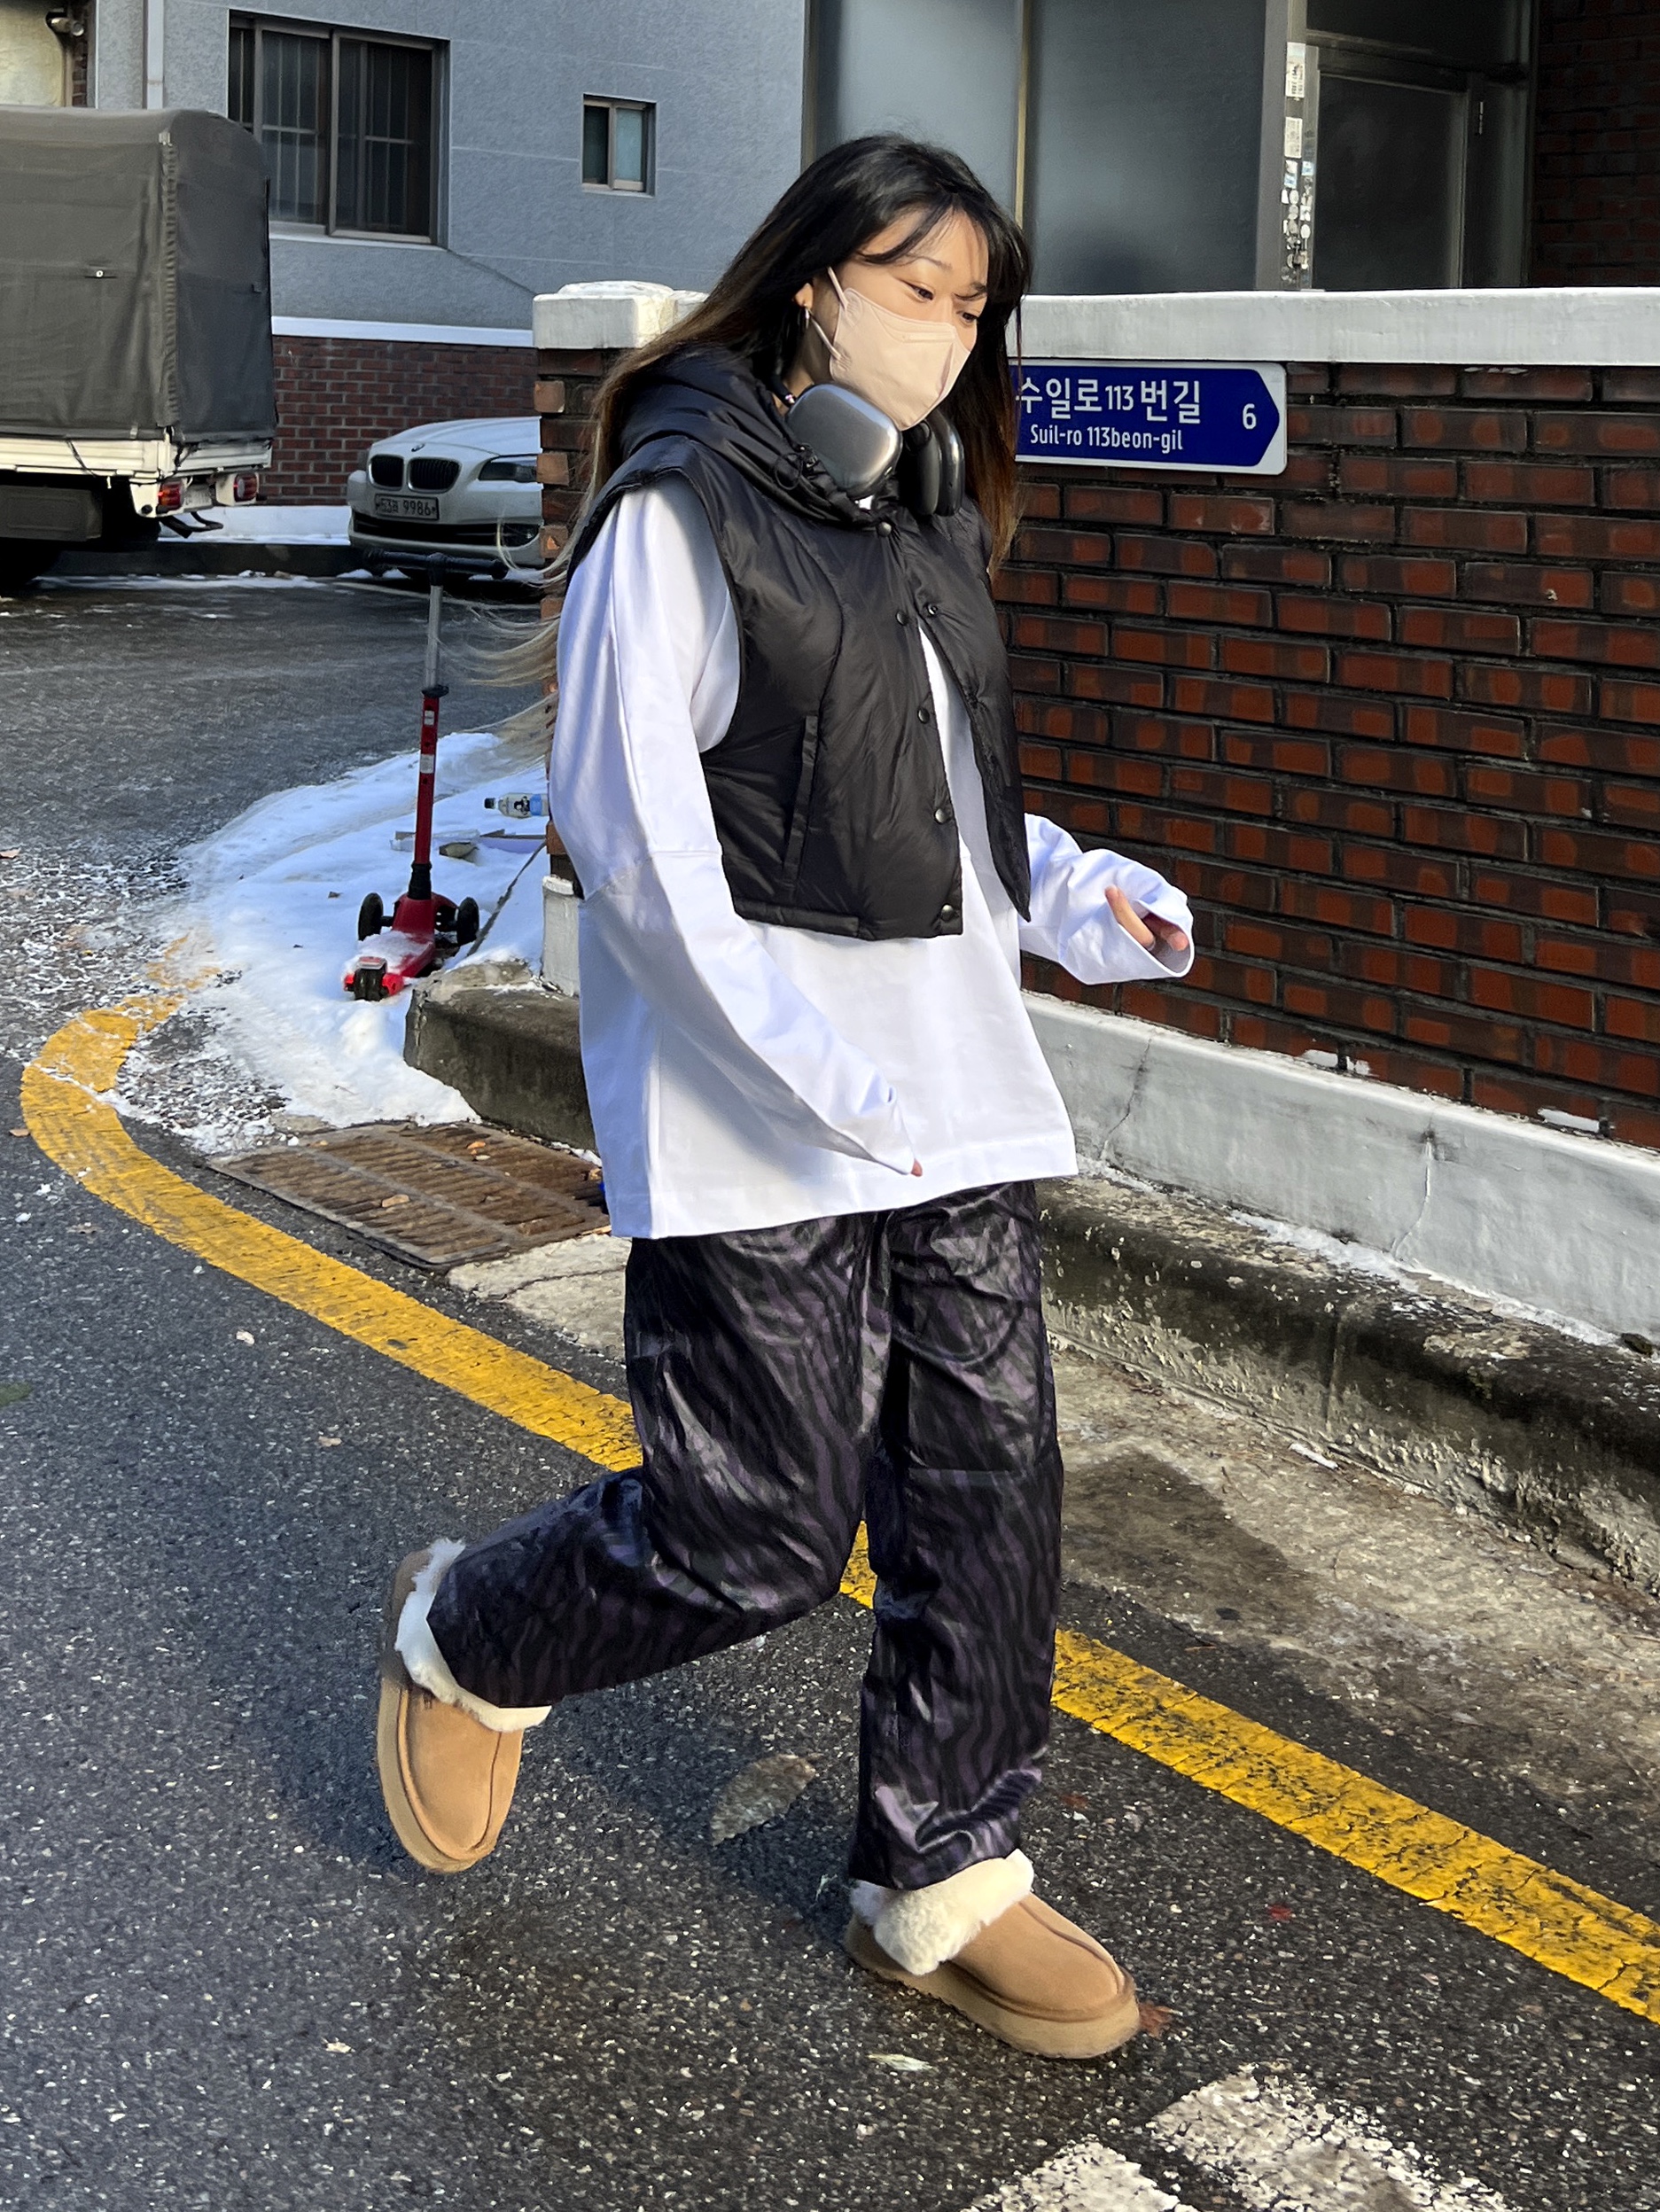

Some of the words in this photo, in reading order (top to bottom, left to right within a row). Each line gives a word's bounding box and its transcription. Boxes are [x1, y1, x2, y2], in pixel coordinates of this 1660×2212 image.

[1016, 377, 1201, 424] 수일로113번길
[1242, 403, 1257, 430] 6
[1030, 424, 1082, 445] Suil-ro
[1087, 426, 1183, 454] 113beon-gil
[403, 499, 431, 516] 9986
